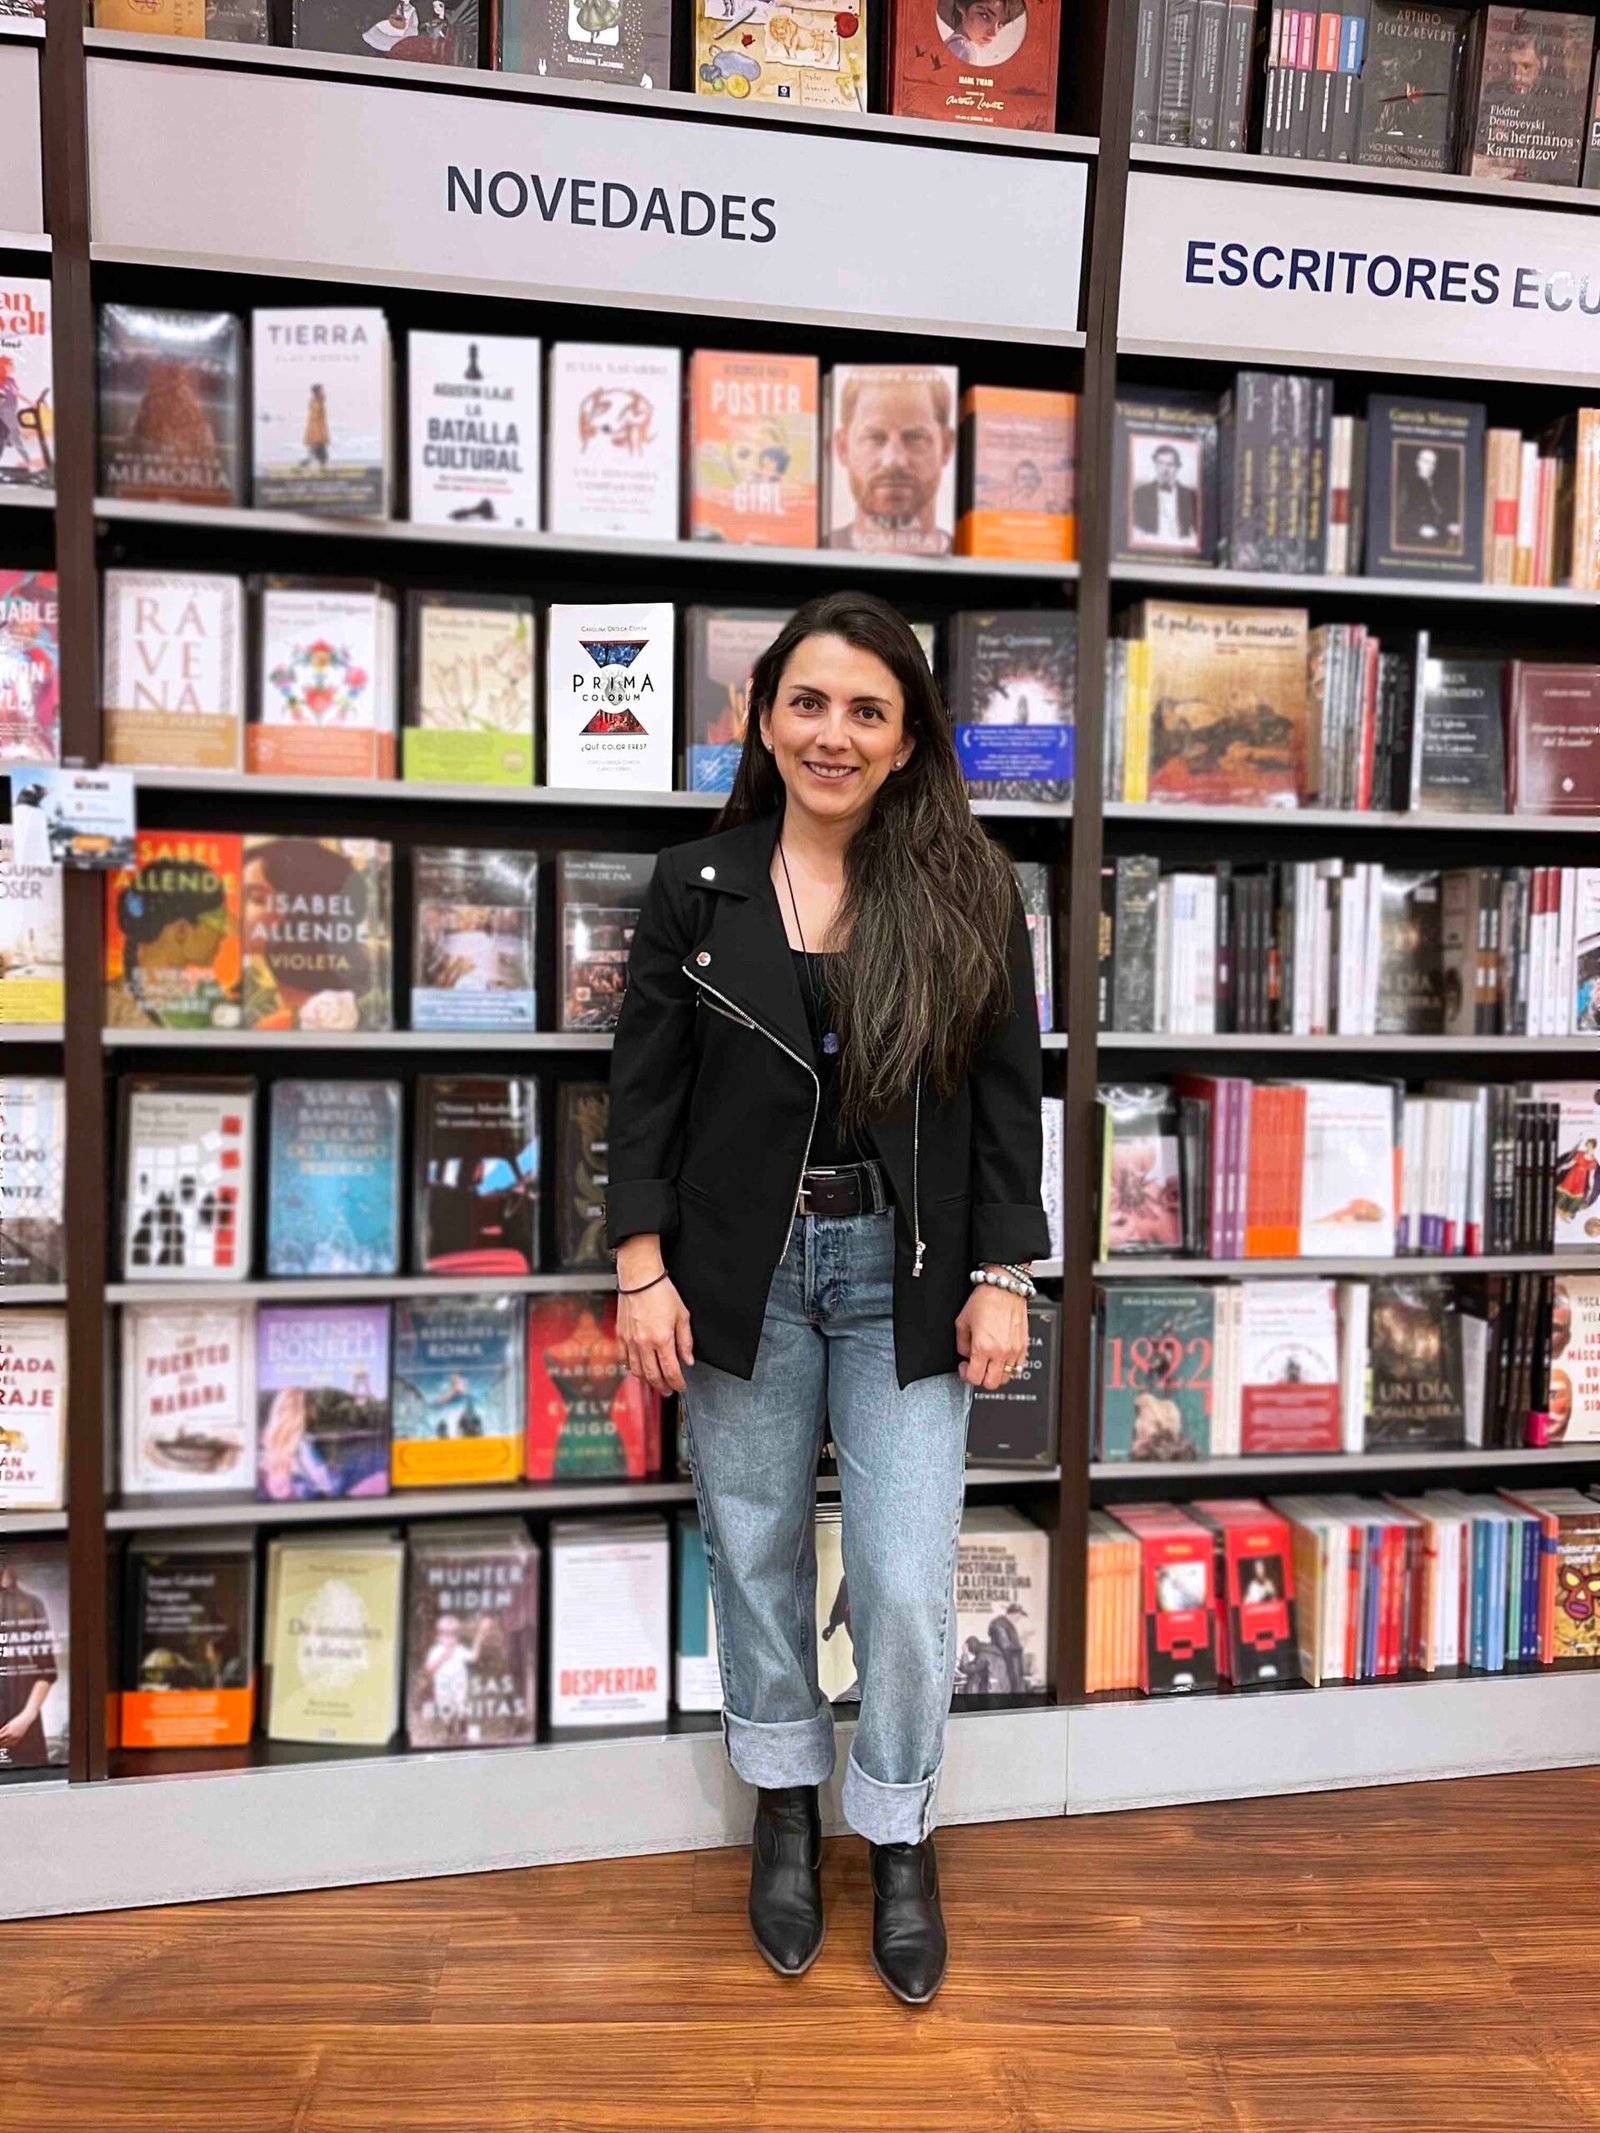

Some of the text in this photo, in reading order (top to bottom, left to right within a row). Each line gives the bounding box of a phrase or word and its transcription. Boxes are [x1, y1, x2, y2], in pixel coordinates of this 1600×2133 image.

[1396, 10, 1442, 25] ARTURO
[1490, 105, 1520, 119] Fiódor
[1488, 128, 1574, 148] Los hermanos
[1486, 143, 1558, 161] Karamázov
[447, 166, 777, 243] NOVEDADES
[1186, 240, 1500, 306] ESCRITORES
[268, 324, 368, 346] TIERRA
[711, 380, 801, 414] POSTER
[465, 403, 482, 418] LA
[427, 417, 519, 446] BATALLA
[422, 444, 524, 473] CULTURAL
[732, 480, 785, 516] GIRL
[136, 640, 201, 679] VE
[573, 673, 654, 693] PRIMA
[582, 693, 641, 702] COLORUM
[581, 742, 648, 752] ¿QUÉ COLOR ERES?
[140, 840, 221, 866] SABEL
[115, 869, 237, 894] ALLENDE
[267, 895, 356, 917] ISABEL
[251, 921, 372, 944] ALLENDE
[270, 953, 350, 970] VIOLETA
[267, 1339, 378, 1362] BONELLI
[1105, 1337, 1213, 1390] 1822
[974, 1392, 1037, 1402] EDWARD GIBBON
[547, 1400, 628, 1417] EVELYN
[558, 1421, 617, 1437] HUGO
[428, 1566, 524, 1586] HUNTER
[957, 1561, 1018, 1575] HISTORIA DE
[957, 1575, 1032, 1589] LA LITERATURA
[437, 1591, 512, 1609] BIDEN
[956, 1588, 1010, 1602] UNIVERSAL
[559, 1665, 658, 1697] DESPERTAR
[422, 1697, 526, 1720] BONITAS
